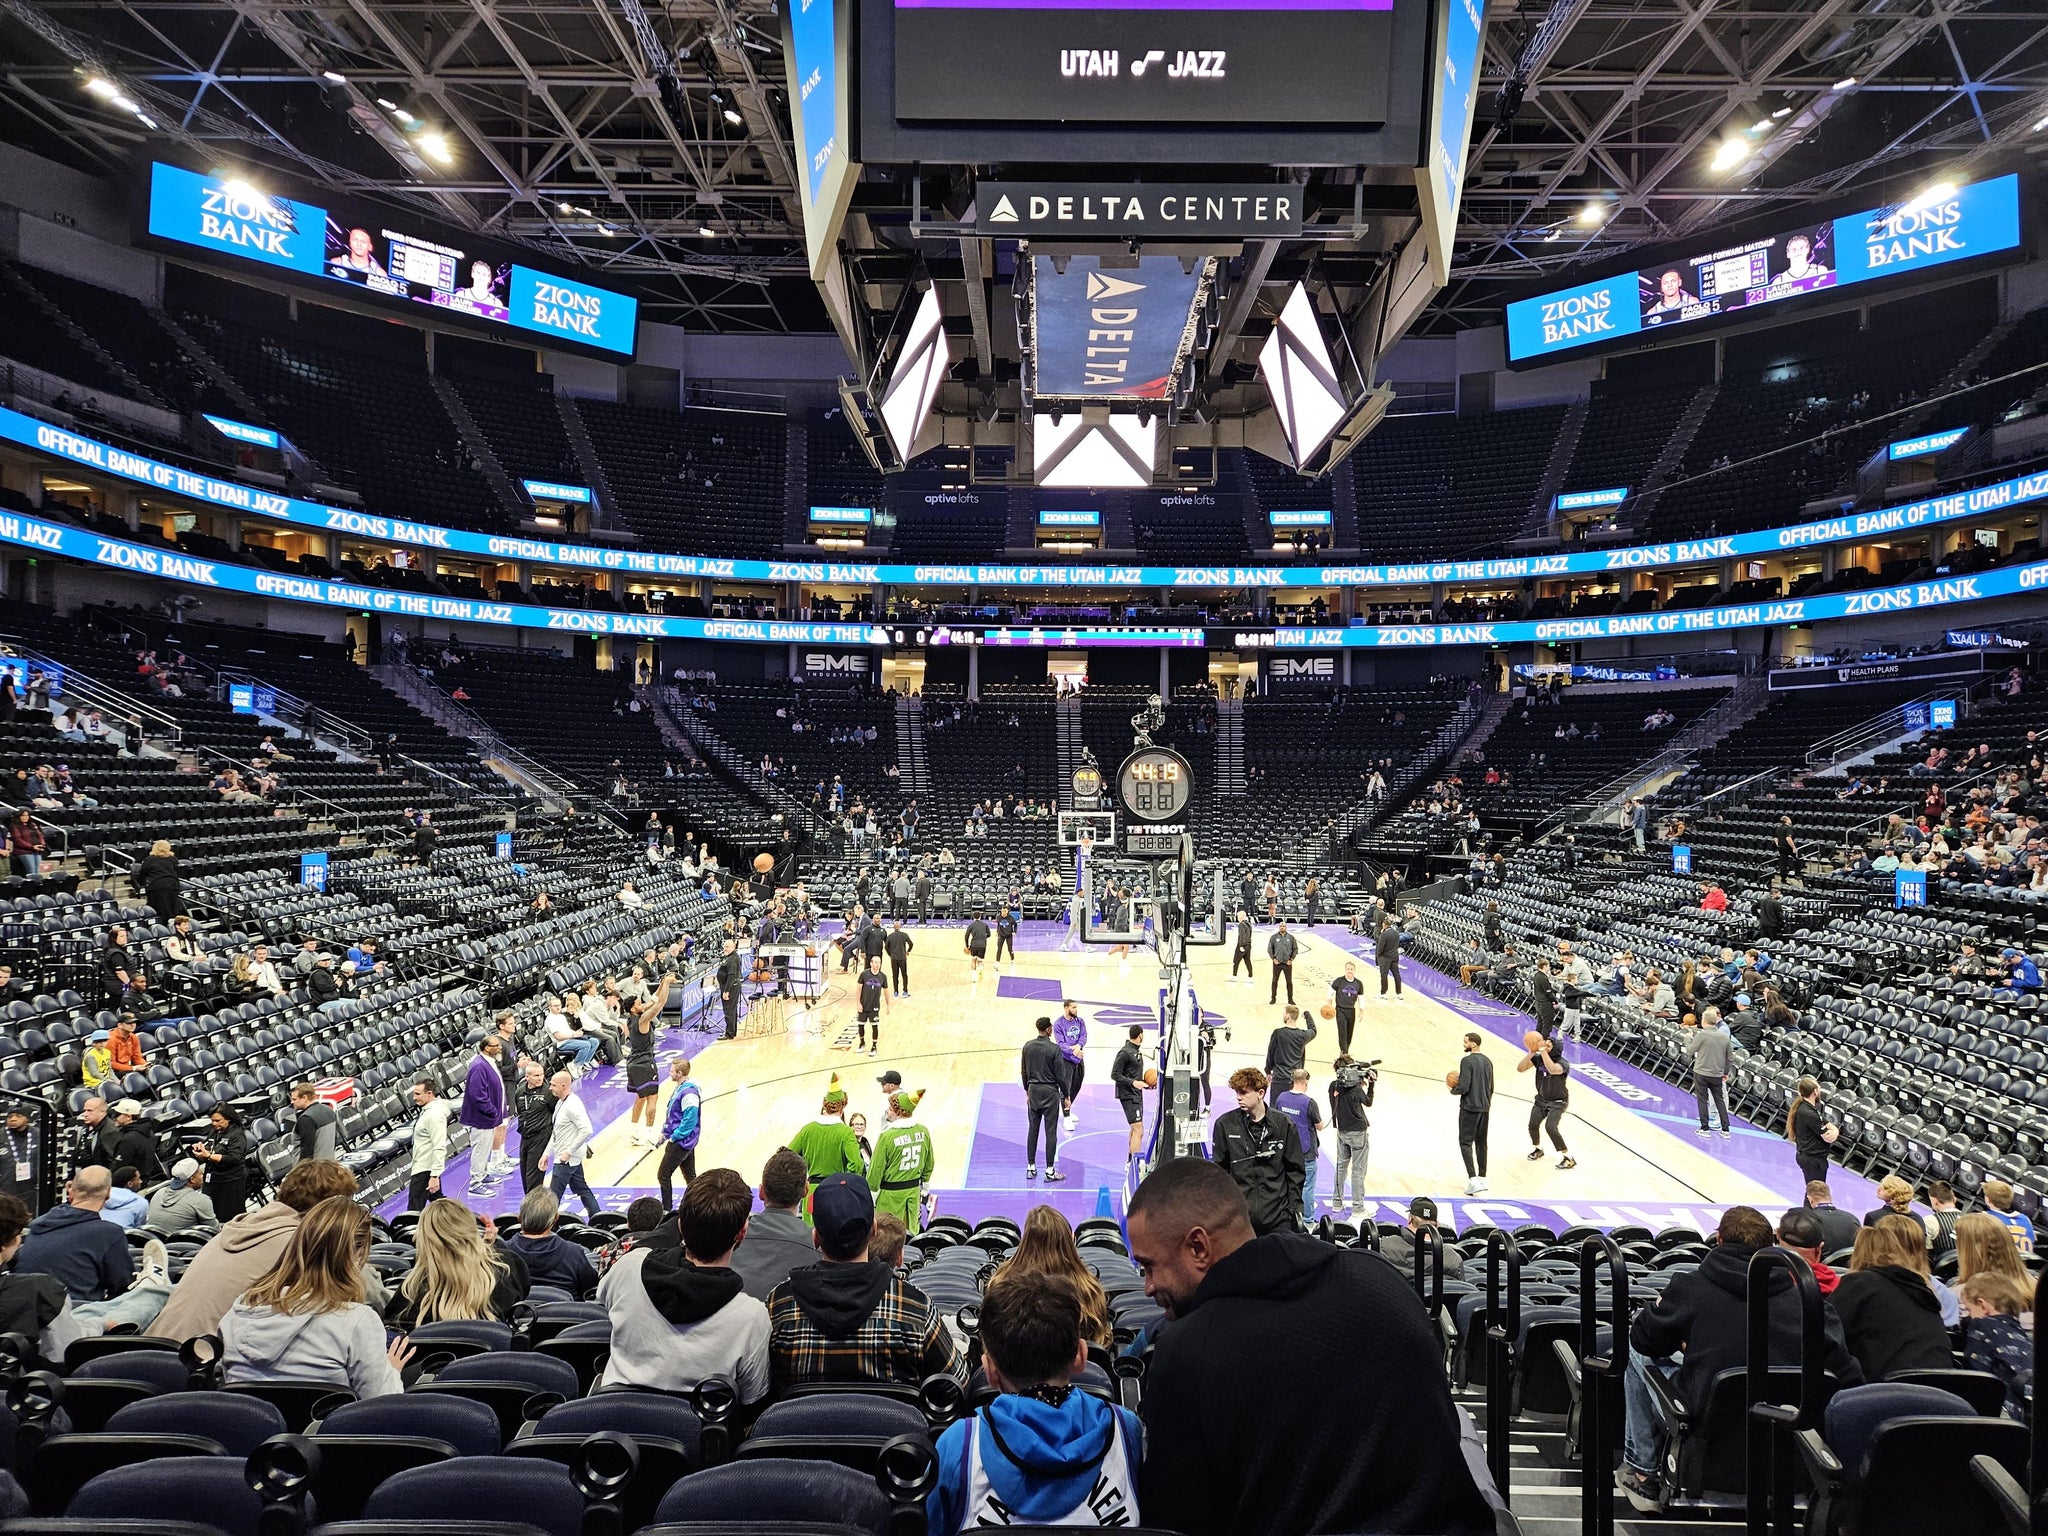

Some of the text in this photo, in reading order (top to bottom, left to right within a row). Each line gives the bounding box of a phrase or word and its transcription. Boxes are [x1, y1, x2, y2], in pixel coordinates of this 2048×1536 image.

[1061, 50, 1226, 77] UTAH JAZZ
[801, 66, 821, 101] BANK
[1030, 197, 1291, 221] DELTA CENTER
[1866, 201, 1961, 243] ZIONS
[199, 213, 294, 258] BANK
[1866, 226, 1966, 268] BANK
[434, 292, 448, 305] 23
[534, 281, 601, 316] ZIONS
[1541, 289, 1611, 323] ZIONS
[1748, 290, 1764, 303] 23
[532, 302, 601, 338] BANK
[1543, 310, 1615, 344] BANK
[1083, 308, 1138, 385] DELTA
[1895, 440, 1928, 455] ZIONS
[38, 427, 288, 516] OFFICIAL BANK OF THE UTAH JAZZ
[925, 494, 980, 505] aptive lofts
[1160, 495, 1215, 506] aptive lofts
[1563, 495, 1592, 506] ZIONS
[327, 510, 387, 537] ZIONS
[814, 509, 839, 518] ZIONS
[1044, 514, 1069, 522] ZIONS
[1780, 521, 1851, 545] OFFICIAL
[1857, 510, 1904, 533] BANK
[1908, 504, 1929, 523] OF
[1932, 496, 1965, 517] THE
[1970, 485, 2010, 510] UTAH
[22, 523, 61, 549] JAZZ
[98, 541, 157, 571] ZIONS
[489, 538, 733, 576] OFFICIAL BANK OF THE UTAH JAZZ
[1607, 547, 1670, 569] ZIONS
[769, 564, 823, 583] ZIONS
[915, 566, 1141, 584] OFFICIAL BANK OF THE UTAH JAZZ
[1175, 568, 1229, 585] ZIONS
[1322, 557, 1568, 584] OFFICIAL BANK OF THE UTAH JAZZ
[256, 575, 511, 621] OFFICIAL BANK OF THE UTAH JAZZ
[1846, 589, 1911, 613] ZIONS
[549, 612, 607, 631] ZIONS
[704, 620, 767, 638] OFFICIAL
[770, 626, 809, 640] BANK
[813, 627, 831, 640] OF
[834, 627, 860, 642] THE
[1536, 603, 1803, 638] OFFICIAL BANK OF THE UTAH JAZZ
[1309, 631, 1343, 644] JAZZ
[1376, 626, 1435, 645] ZIONS
[806, 654, 869, 671] SME
[1269, 658, 1333, 675] SME
[1851, 667, 1875, 676] HEALTH
[1877, 665, 1899, 674] PLANS
[1132, 763, 1178, 780] 44:19
[1143, 825, 1185, 834] TISSOT
[899, 1145, 921, 1170] 25
